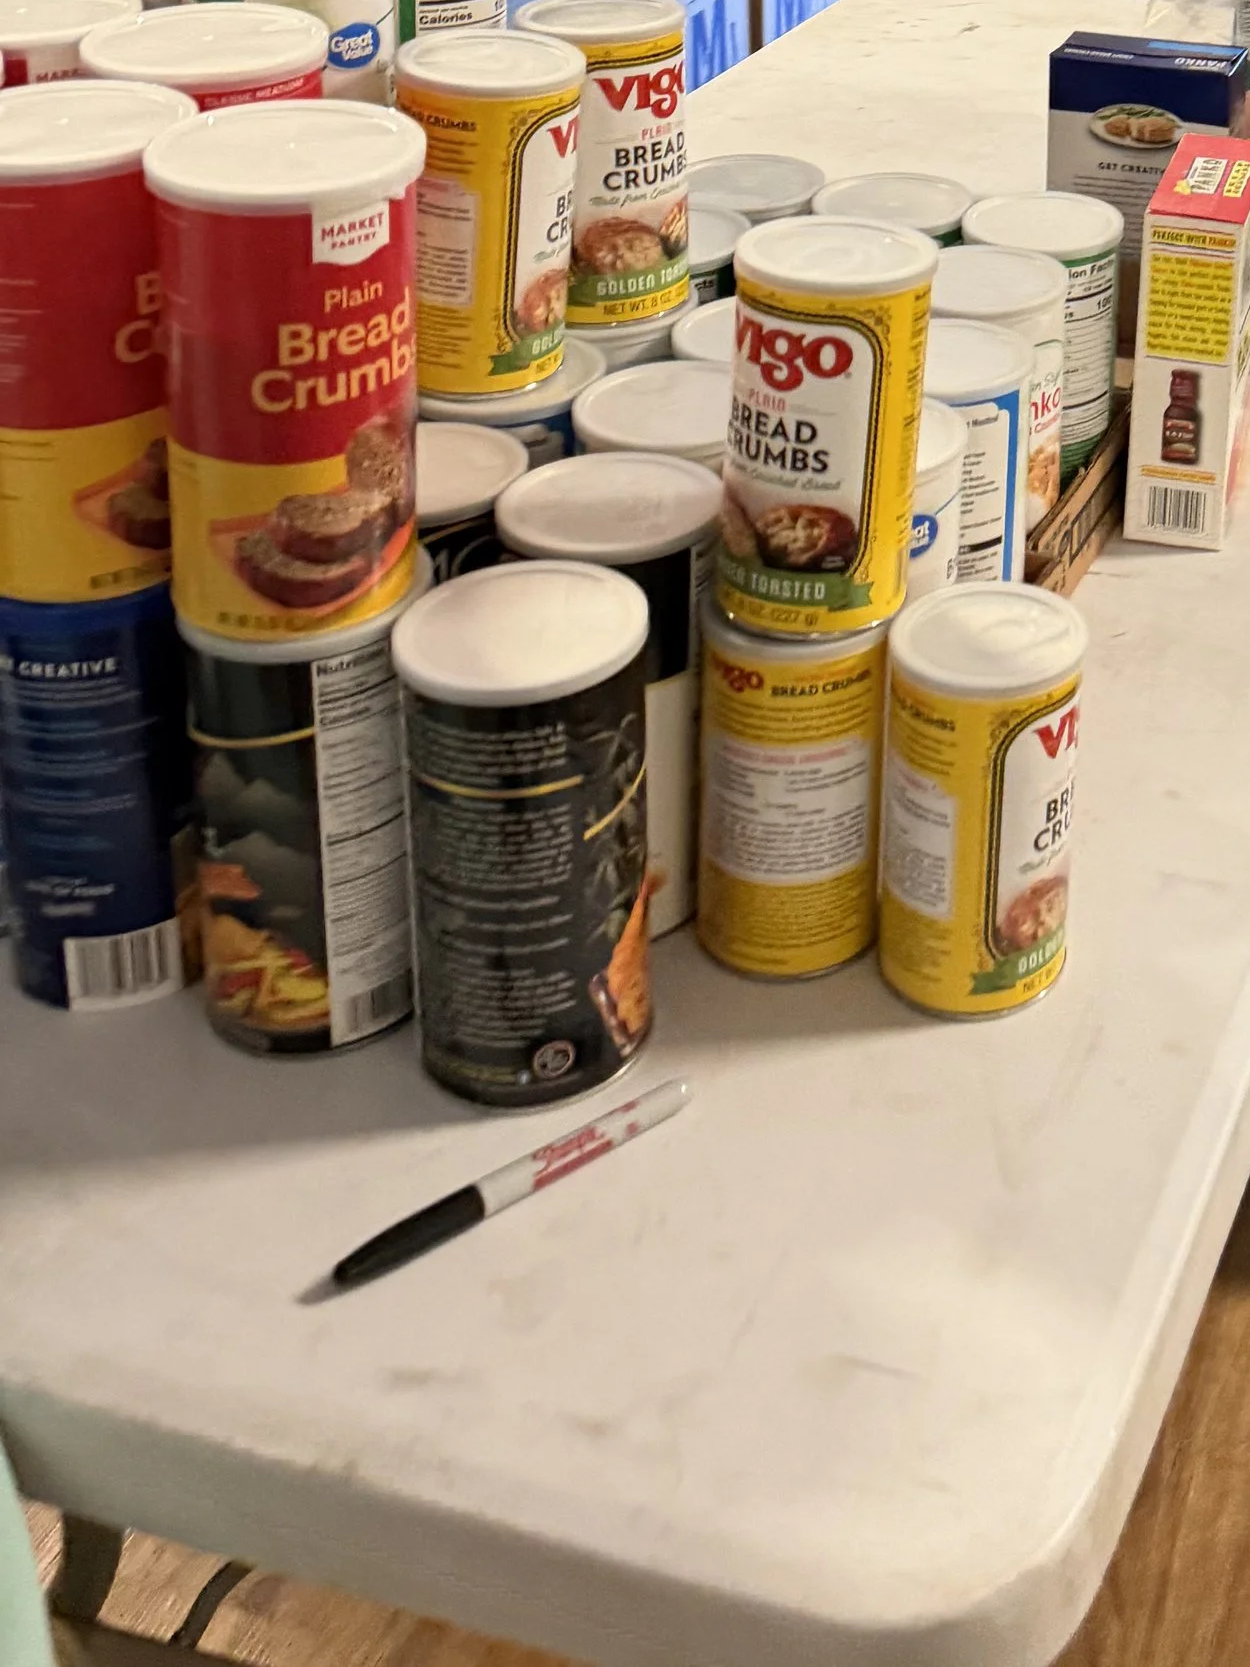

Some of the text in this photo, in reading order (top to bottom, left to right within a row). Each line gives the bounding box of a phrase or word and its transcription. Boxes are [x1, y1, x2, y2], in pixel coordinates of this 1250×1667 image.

[418, 12, 473, 26] Calories
[330, 28, 373, 53] Great
[614, 131, 684, 168] BREAD
[321, 213, 384, 243] MARKET
[331, 232, 377, 250] PANTRY
[324, 280, 382, 314] Plain
[596, 272, 656, 296] GOLDEN
[278, 286, 410, 367] Bread
[731, 395, 818, 446] BREAD
[751, 573, 826, 601] TOASTED
[18, 657, 118, 679] CREATIVE
